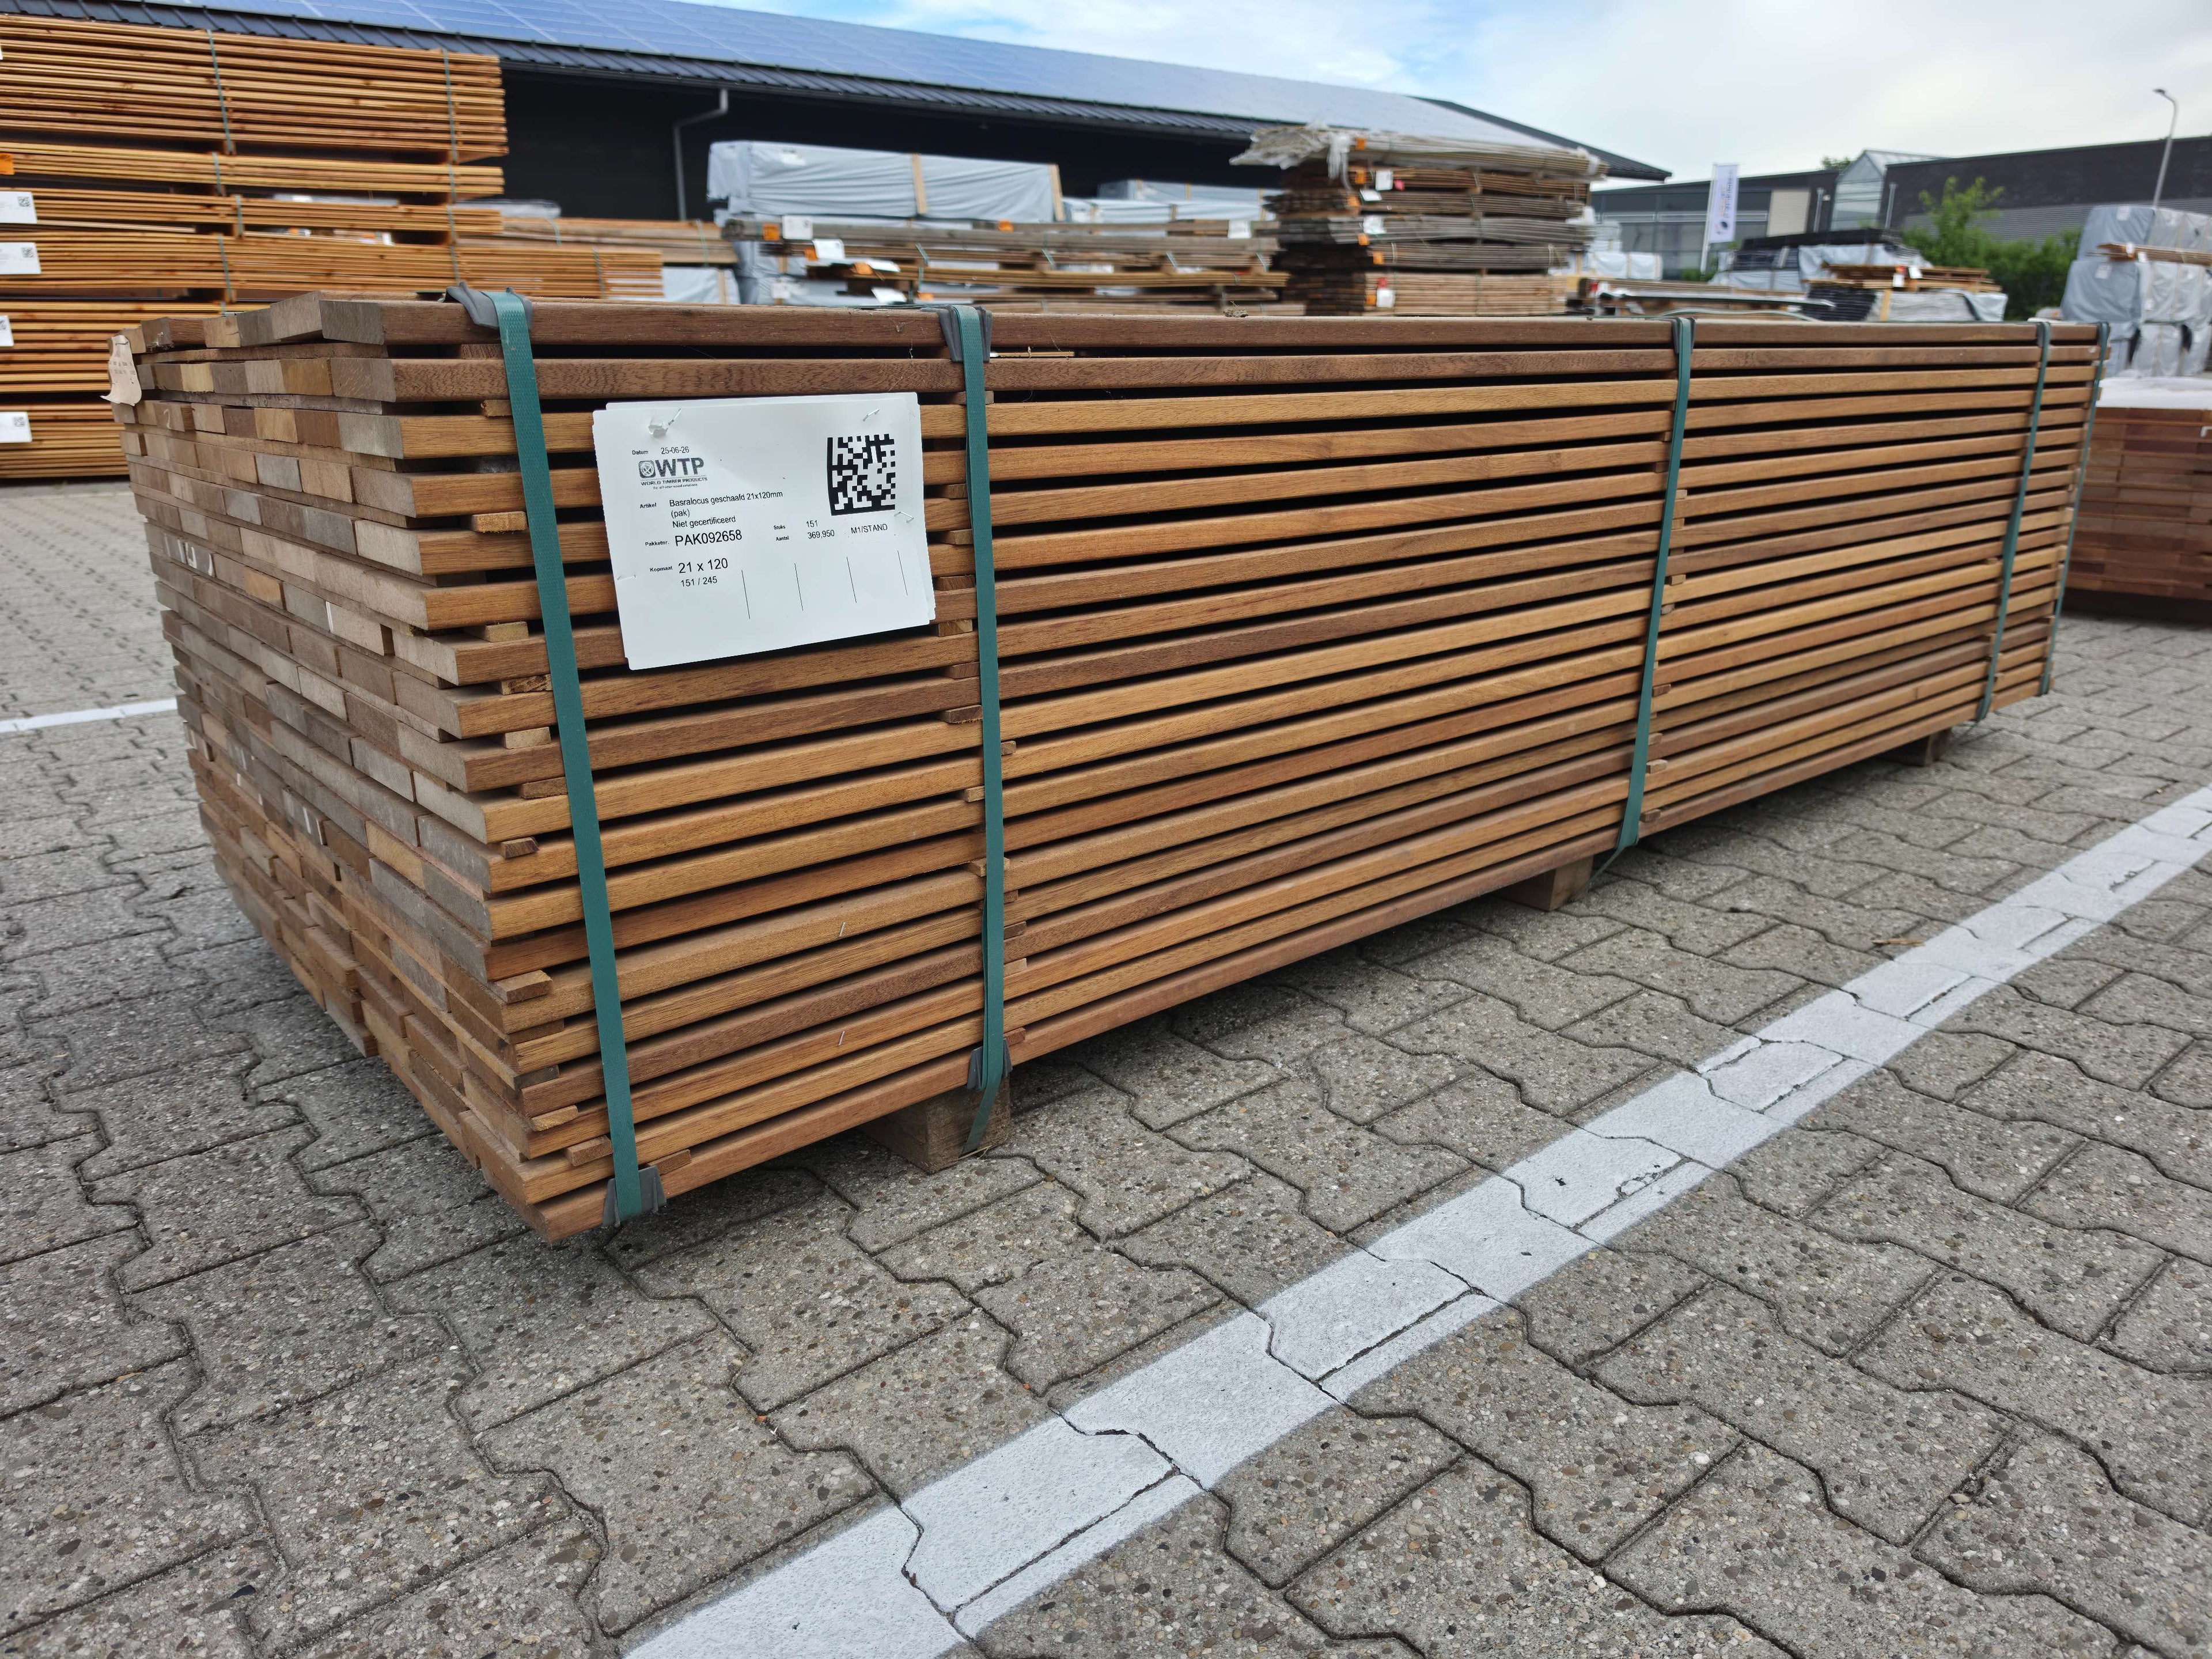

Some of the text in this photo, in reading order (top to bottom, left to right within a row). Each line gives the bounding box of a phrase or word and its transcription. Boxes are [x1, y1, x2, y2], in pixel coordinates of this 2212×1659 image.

[661, 446, 690, 454] 25-06-26
[655, 457, 704, 477] WTP
[669, 497, 709, 507] Basralocus
[710, 494, 745, 505] geschaafd
[747, 491, 783, 501] 21x120mm
[671, 509, 690, 518] (pak)
[672, 516, 736, 528] Niet gecertificeerd
[806, 520, 818, 528] 151
[808, 529, 835, 539] 369,950
[851, 523, 888, 534] M1/STAND
[675, 529, 742, 547] PAK092658
[679, 562, 692, 574] 21
[697, 563, 704, 571] x
[707, 558, 728, 570] 120
[681, 575, 718, 587] 151 / 245
